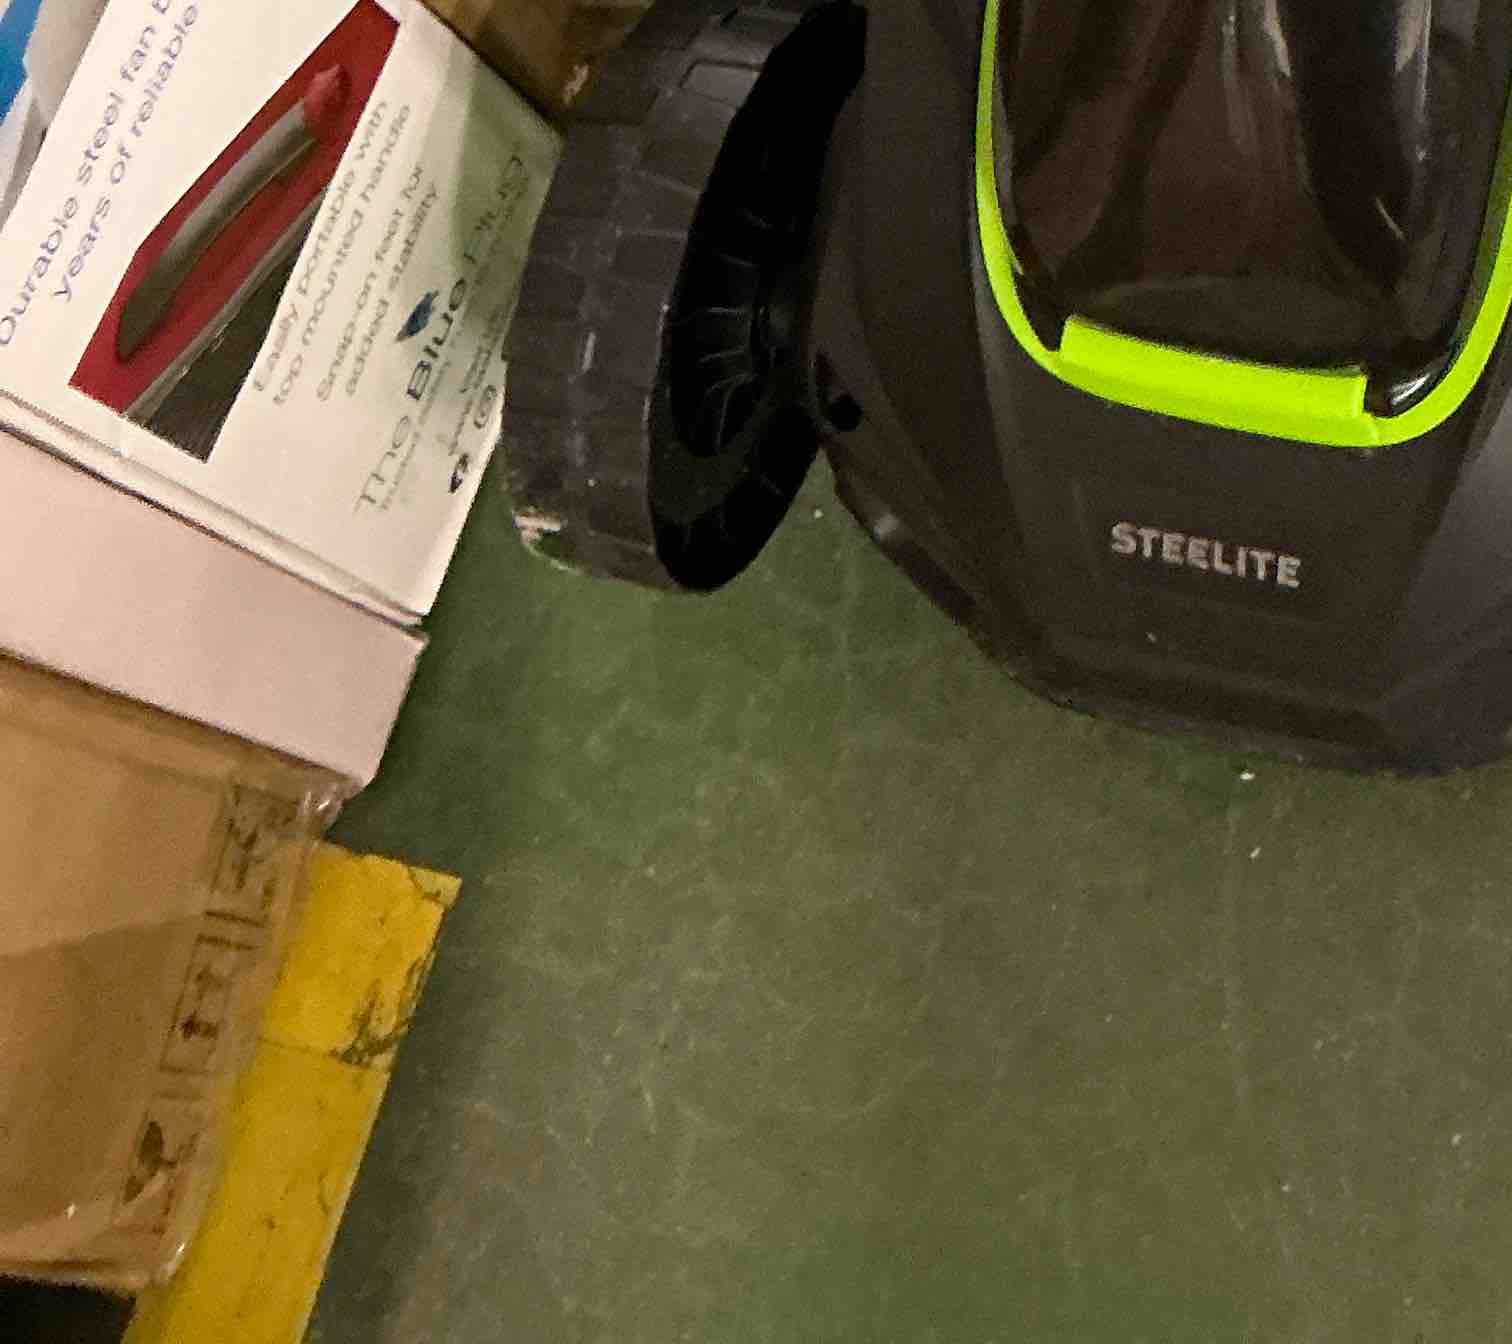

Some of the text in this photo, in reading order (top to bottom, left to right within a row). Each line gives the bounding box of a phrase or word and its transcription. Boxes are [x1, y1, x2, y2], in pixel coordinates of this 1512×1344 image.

[53, 194, 111, 302] years
[109, 141, 132, 184] of
[131, 5, 198, 137] reliable
[77, 91, 124, 186] steel
[120, 24, 157, 82] fan
[297, 169, 355, 296] portable
[354, 99, 387, 161] with
[273, 103, 411, 405] top mounted handle
[346, 181, 439, 397] added stability
[353, 415, 410, 514] The
[406, 277, 467, 402] Blue
[1110, 520, 1301, 588] STEELITE
